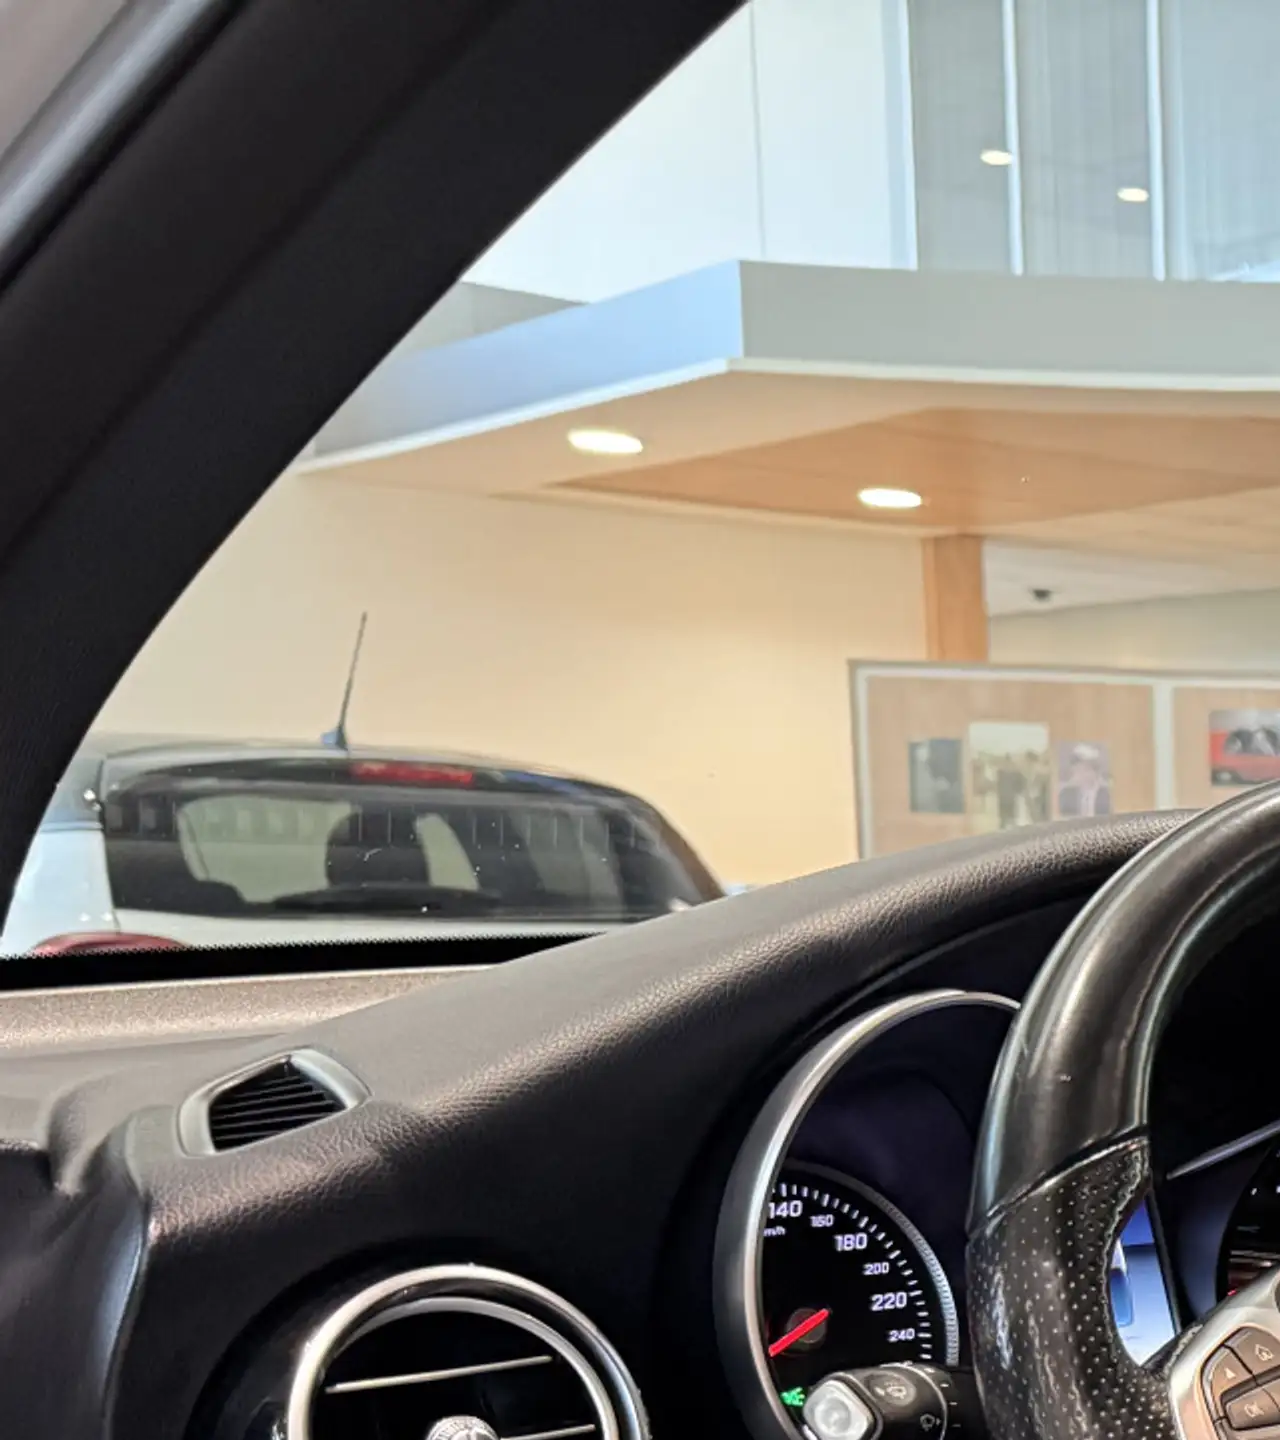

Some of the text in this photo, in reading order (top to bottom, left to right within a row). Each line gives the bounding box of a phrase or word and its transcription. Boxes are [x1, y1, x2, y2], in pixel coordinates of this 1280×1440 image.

[767, 1200, 803, 1218] 140
[809, 1214, 834, 1228] 160
[763, 1226, 786, 1237] m/h
[833, 1233, 868, 1252] 180
[863, 1262, 890, 1276] 200
[870, 1292, 908, 1312] 220
[888, 1328, 916, 1343] 240
